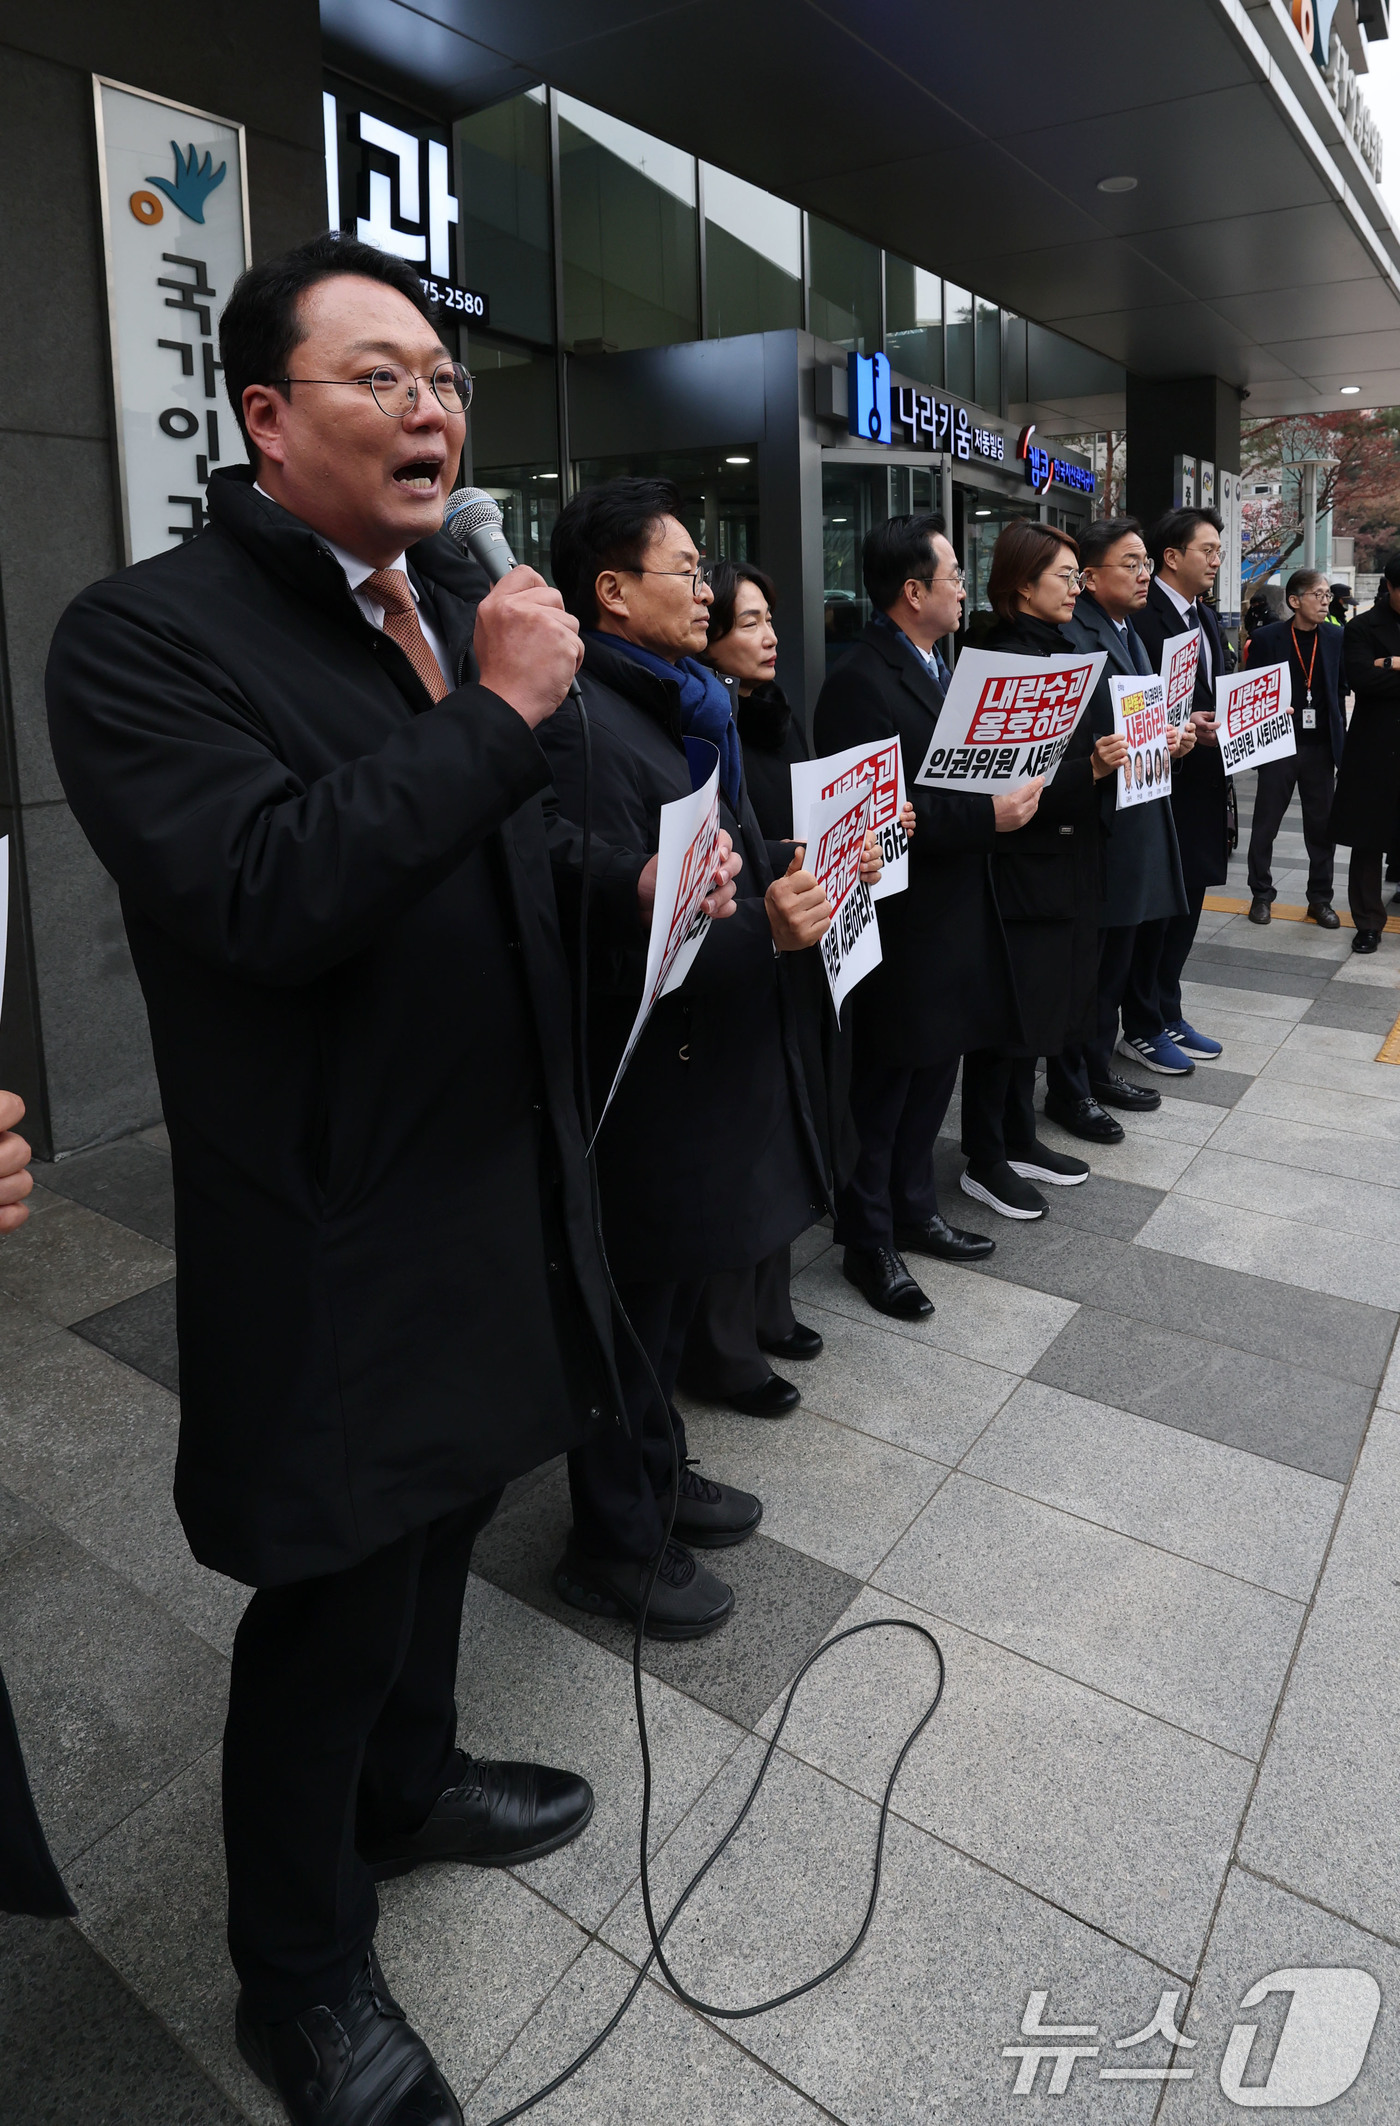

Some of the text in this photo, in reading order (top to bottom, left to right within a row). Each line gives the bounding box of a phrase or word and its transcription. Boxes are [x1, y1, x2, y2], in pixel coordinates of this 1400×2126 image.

[900, 386, 1005, 462] 나라키움 저동빌딩
[1028, 444, 1049, 488] 캠코
[983, 668, 1091, 710] 내란수괴
[1230, 671, 1280, 711] 내란수괴
[972, 702, 1077, 742] 옹호하는
[1229, 695, 1279, 735] 옹호하는
[1223, 713, 1292, 769] 인권위원 사퇴하라!
[924, 747, 1020, 779] 인권위원
